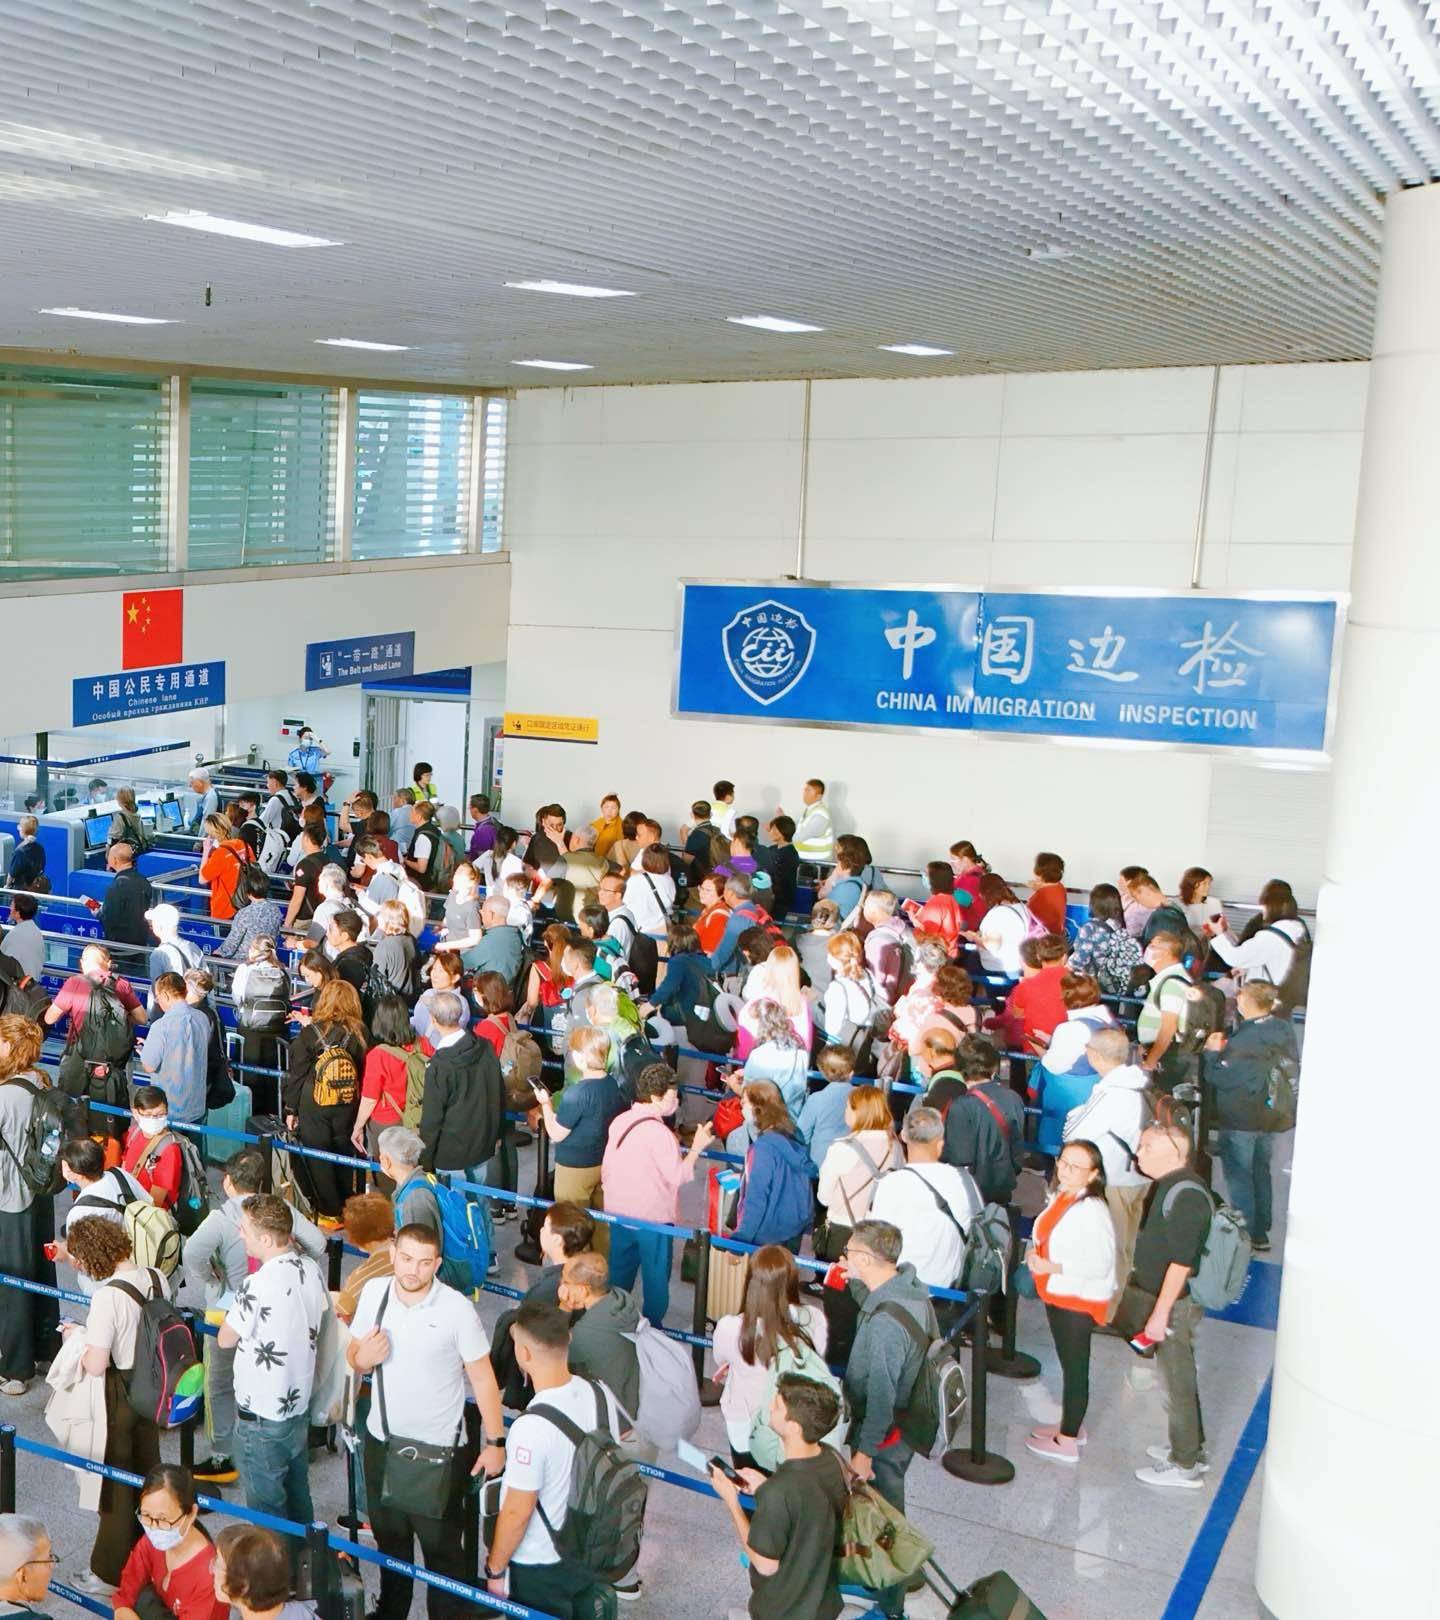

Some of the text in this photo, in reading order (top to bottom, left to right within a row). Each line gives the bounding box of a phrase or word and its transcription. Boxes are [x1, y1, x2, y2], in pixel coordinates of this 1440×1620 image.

[884, 609, 1265, 696] 中国边检
[92, 668, 209, 700] 中国公民专用通道
[128, 693, 177, 707] Chinese lane
[876, 691, 1258, 729] CHINA IMMIGRATION INSPECTION
[64, 1291, 92, 1304] INSPECT
[86, 1462, 145, 1487] CHINA IMMIGRA
[386, 1558, 529, 1618] CHINA IMMIGRATION INSPECTION
